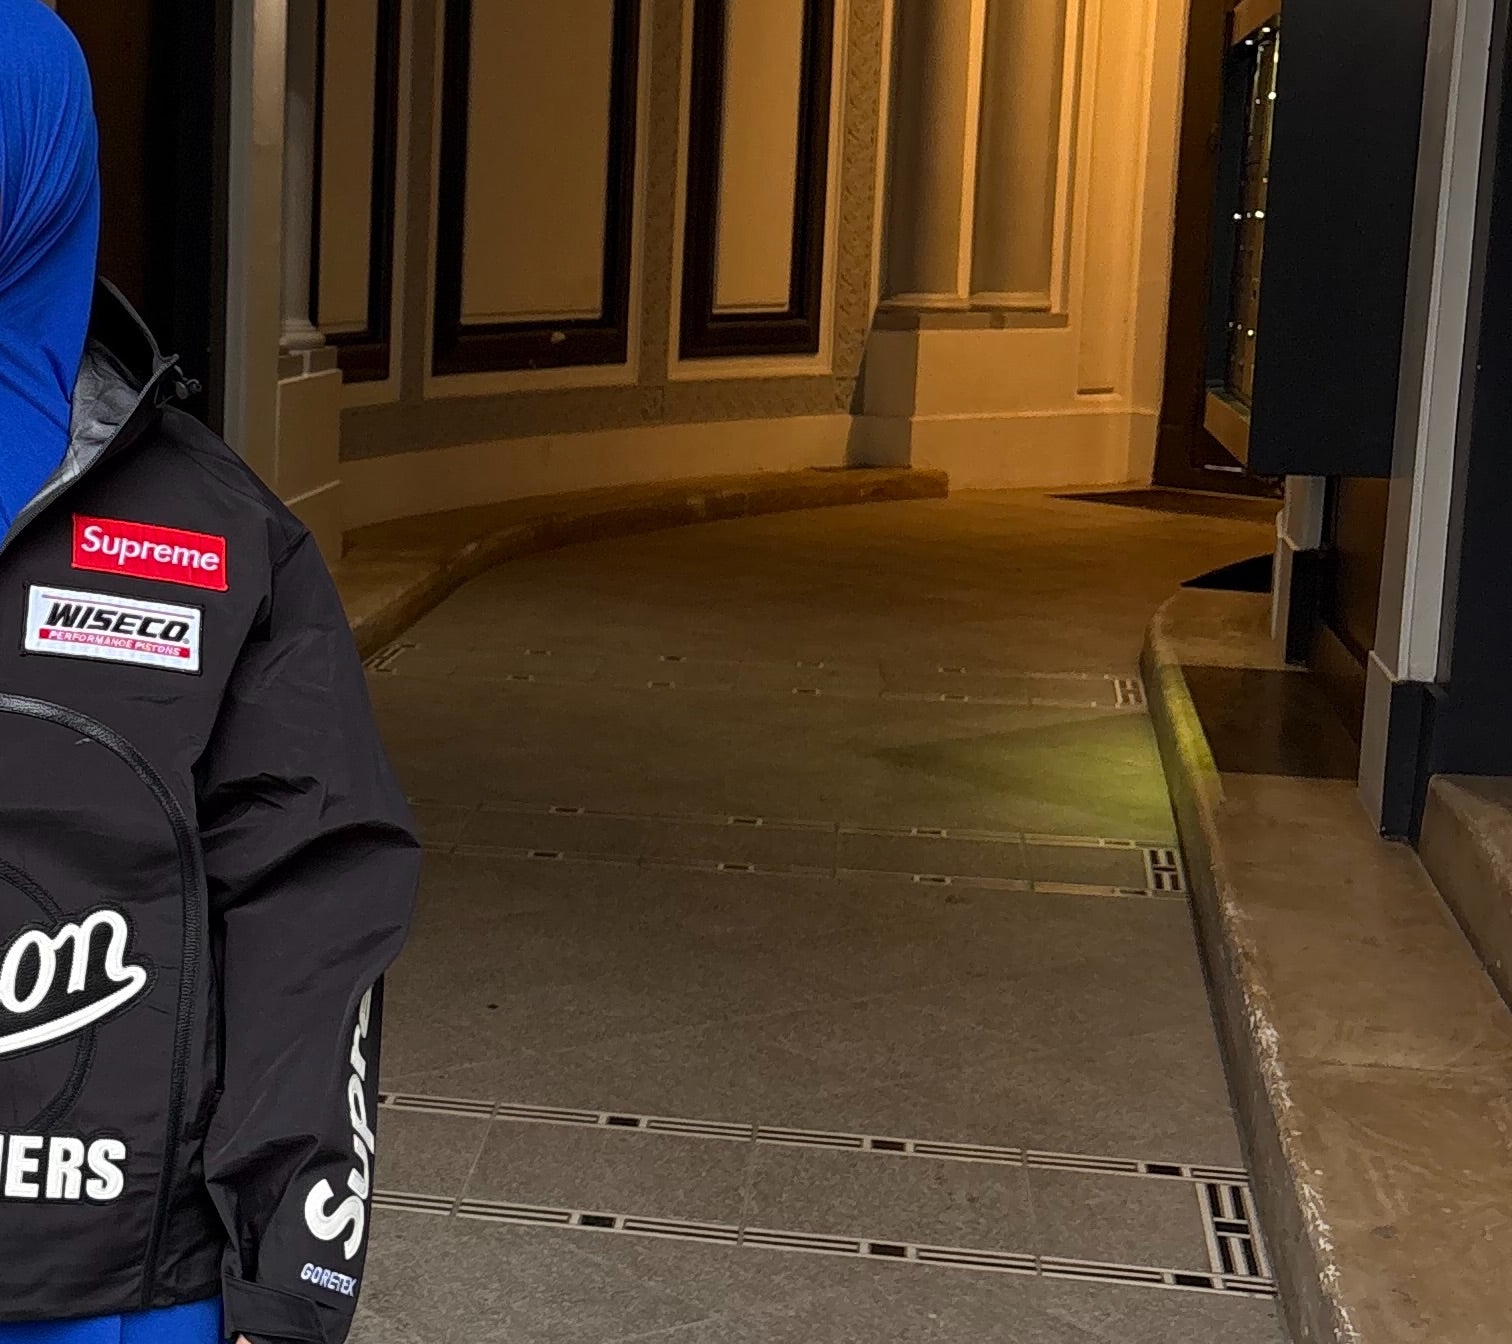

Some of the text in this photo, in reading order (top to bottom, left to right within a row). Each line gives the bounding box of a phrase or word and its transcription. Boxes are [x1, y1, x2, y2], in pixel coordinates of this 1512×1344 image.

[81, 525, 221, 571] Supreme
[45, 602, 190, 643] WISECO
[48, 630, 182, 657] PERFORMANCE PISTONS
